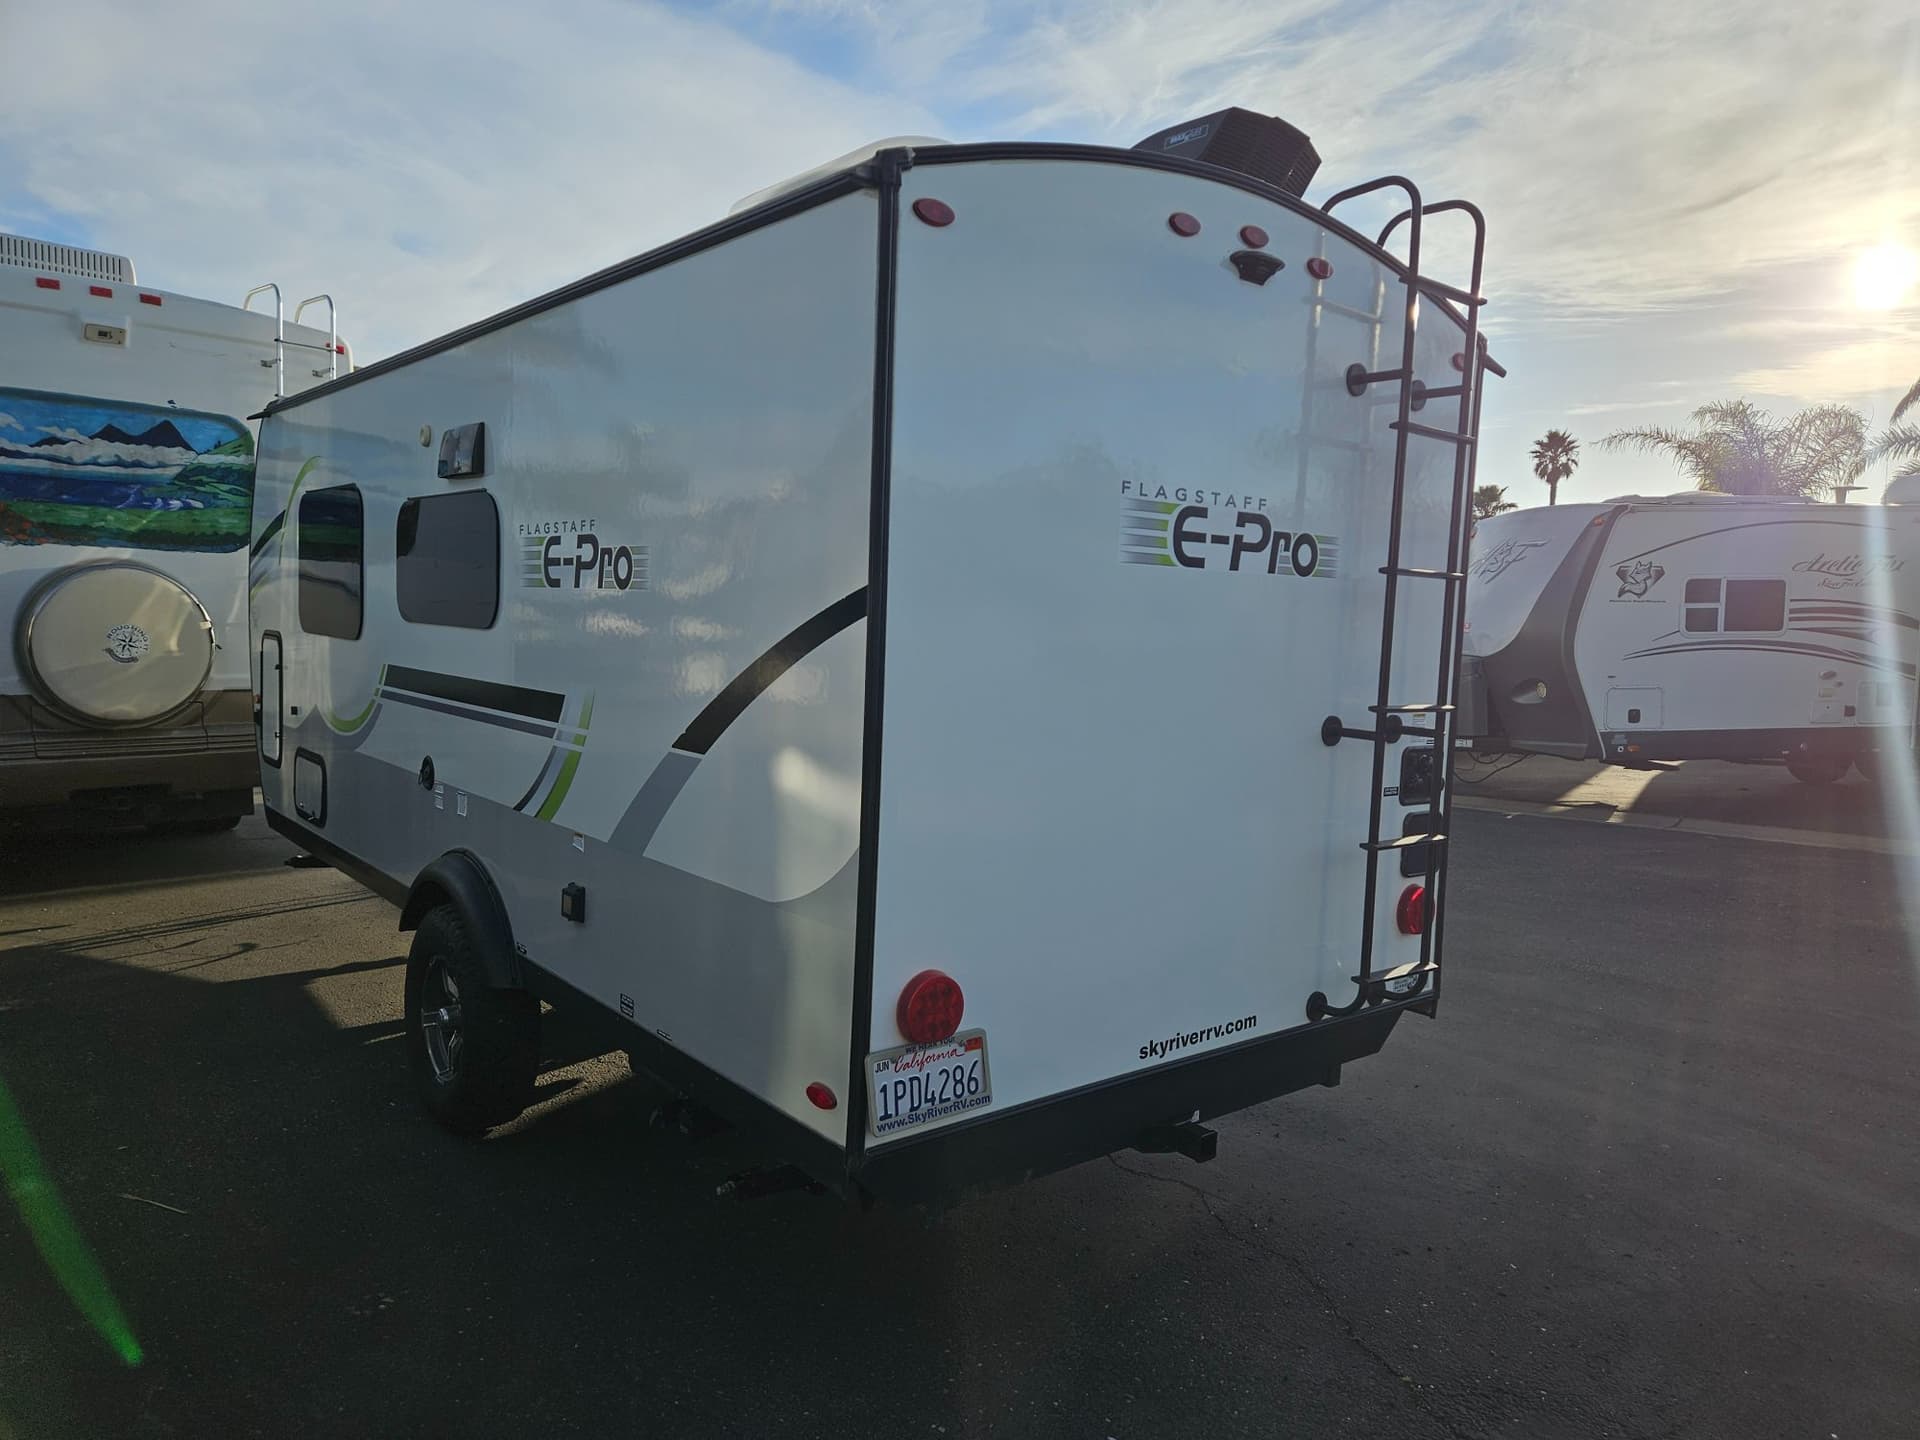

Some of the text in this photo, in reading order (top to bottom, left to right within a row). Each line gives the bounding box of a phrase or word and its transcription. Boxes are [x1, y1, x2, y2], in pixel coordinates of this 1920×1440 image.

[1121, 480, 1268, 511] FLAGSTAFF
[519, 519, 596, 535] FLAGSTAFF
[1172, 504, 1320, 577] E-Pro
[543, 533, 633, 590] E-Pro
[1139, 1015, 1257, 1059] skyriverrv.com
[875, 1060, 890, 1073] JUN
[894, 1046, 965, 1073] California
[879, 1060, 979, 1121] 1PD4286
[876, 1095, 991, 1132] www.SkyRiverRV.com
